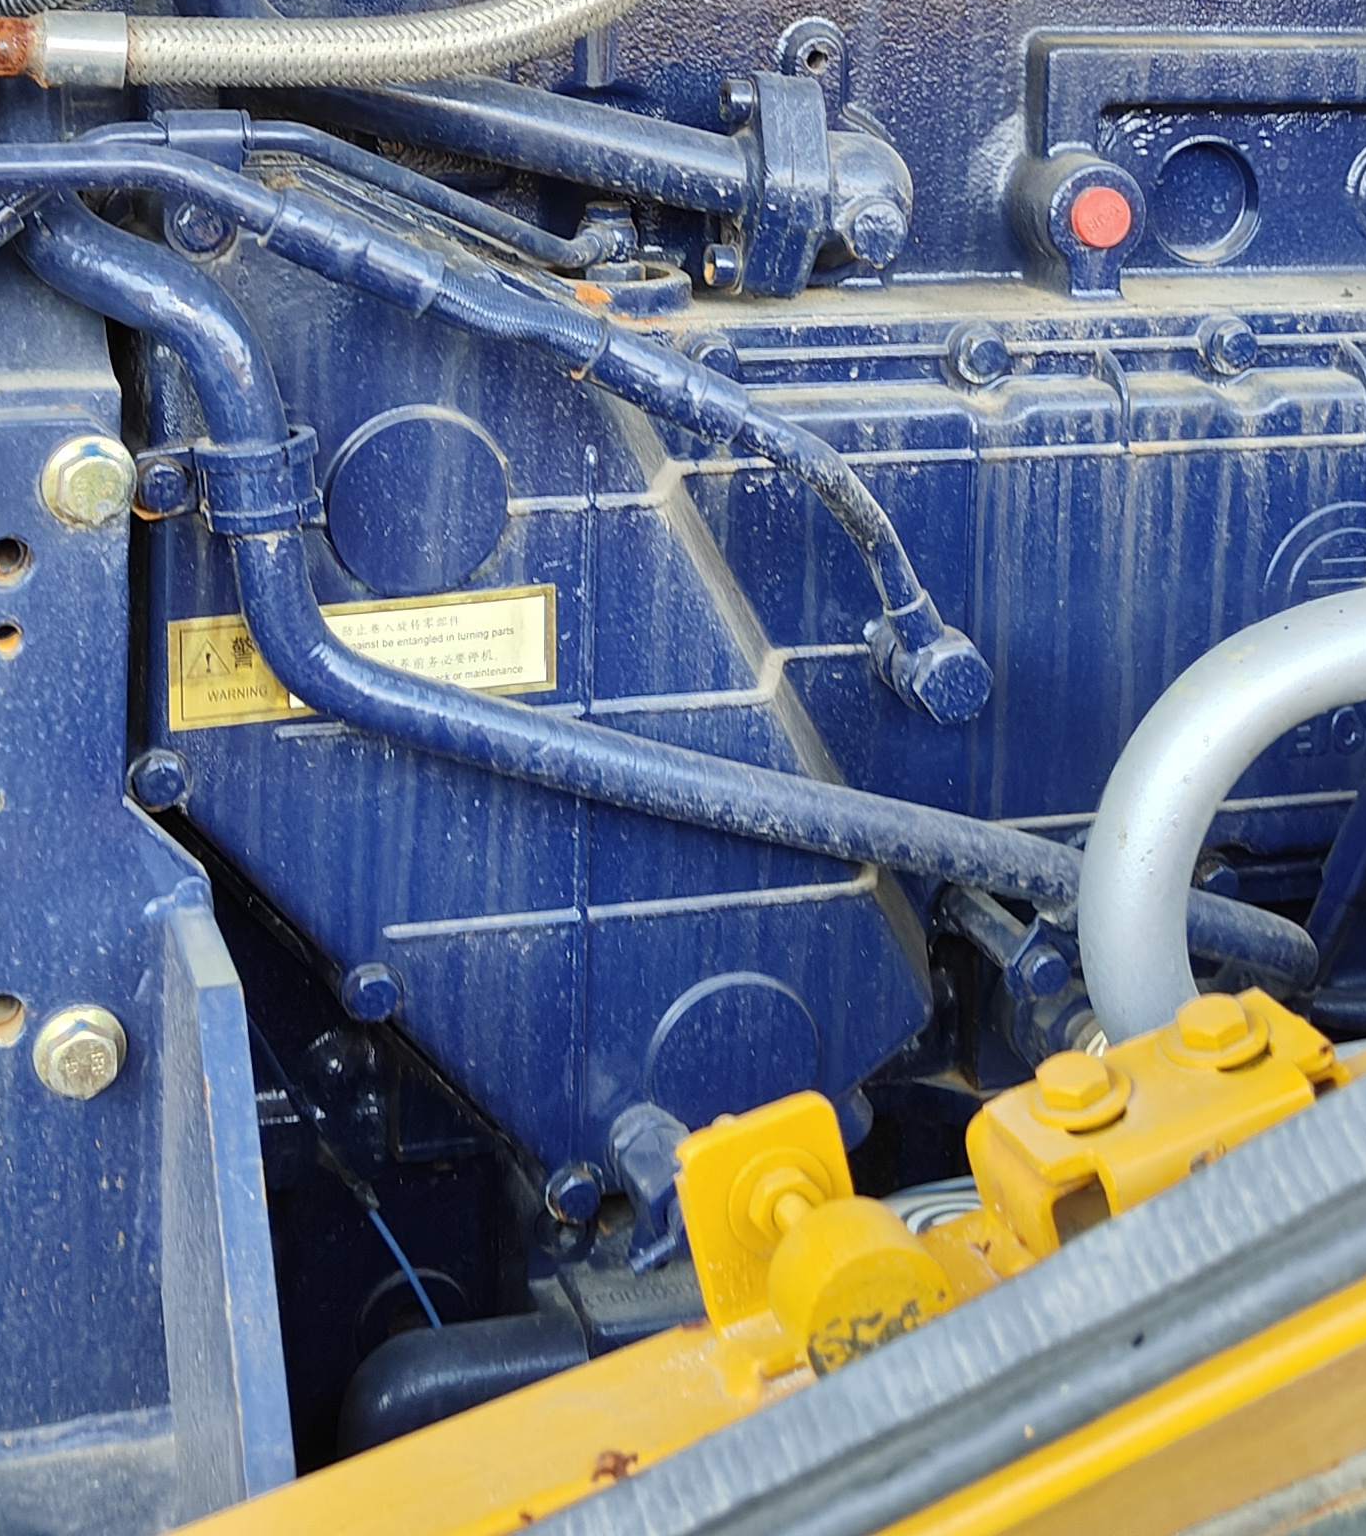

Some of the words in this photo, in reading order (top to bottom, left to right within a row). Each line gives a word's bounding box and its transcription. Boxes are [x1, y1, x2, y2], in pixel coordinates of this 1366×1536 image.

[350, 639, 380, 651] gainst
[382, 638, 395, 648] be
[397, 633, 444, 647] entangled
[446, 633, 455, 642] in
[457, 629, 489, 641] turning
[491, 626, 515, 638] parts
[207, 685, 269, 703] WARNING
